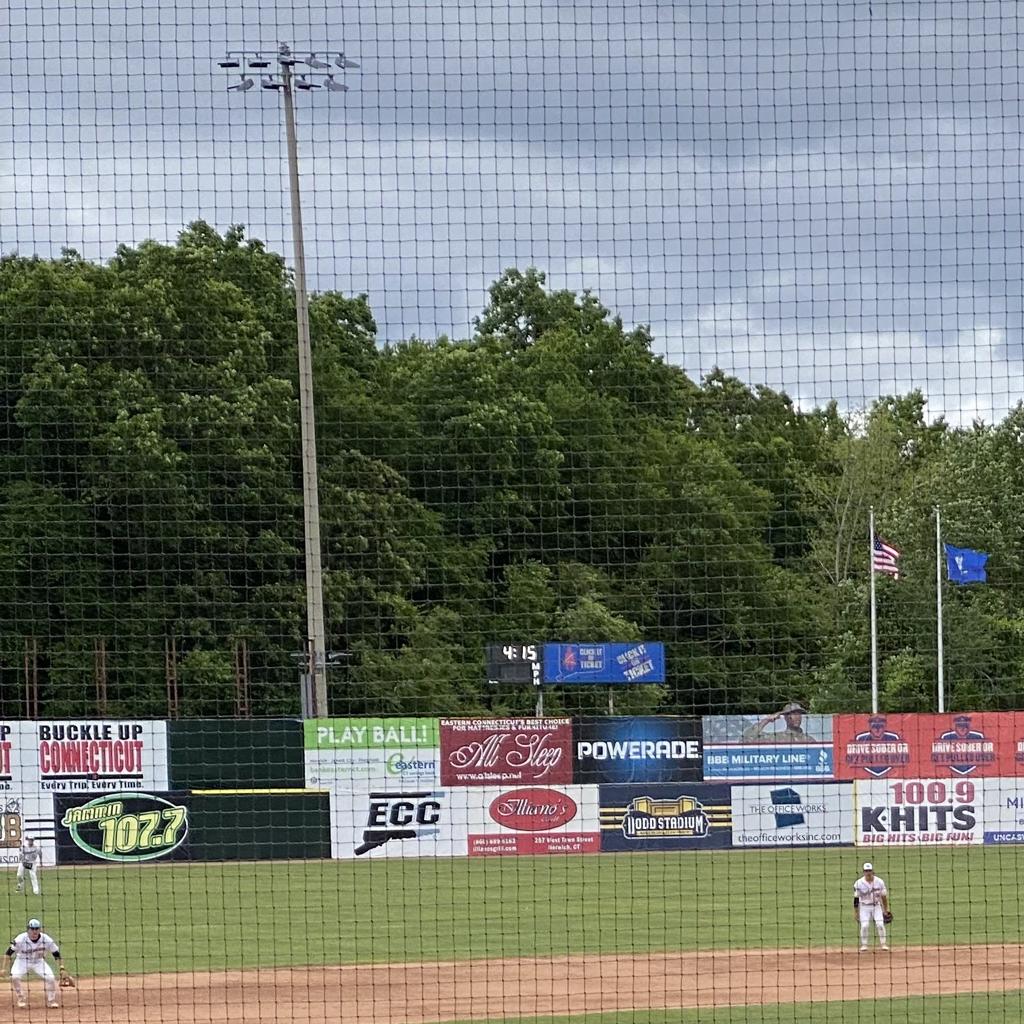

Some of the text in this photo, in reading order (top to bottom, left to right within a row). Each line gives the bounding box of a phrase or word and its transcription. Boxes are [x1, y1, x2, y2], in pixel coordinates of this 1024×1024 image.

[502, 645, 537, 661] 4:15
[472, 718, 525, 726] CONNECTICUT'S
[39, 724, 143, 741] BUCKLE UP
[317, 724, 428, 744] PLAY BALL!
[505, 733, 562, 778] Sleep
[577, 740, 699, 760] POWERADE
[846, 743, 870, 754] DRIVE
[897, 743, 909, 753] OR
[932, 742, 956, 753] DRIVE
[982, 742, 994, 753] OR
[39, 741, 144, 774] CONNECTICUT
[395, 758, 435, 770] eastern
[731, 754, 780, 764] MILITARY
[782, 753, 806, 763] LINE
[41, 781, 66, 791] Every
[92, 780, 116, 790] Every
[889, 780, 975, 805] 100.9
[368, 801, 441, 827] ECC
[750, 805, 767, 814] THE
[98, 807, 187, 854] 107.7
[658, 815, 704, 834] STADIUM
[738, 832, 841, 843] theofficeworksinc.com
[863, 834, 885, 843] BIG
[920, 833, 941, 842] BIG
